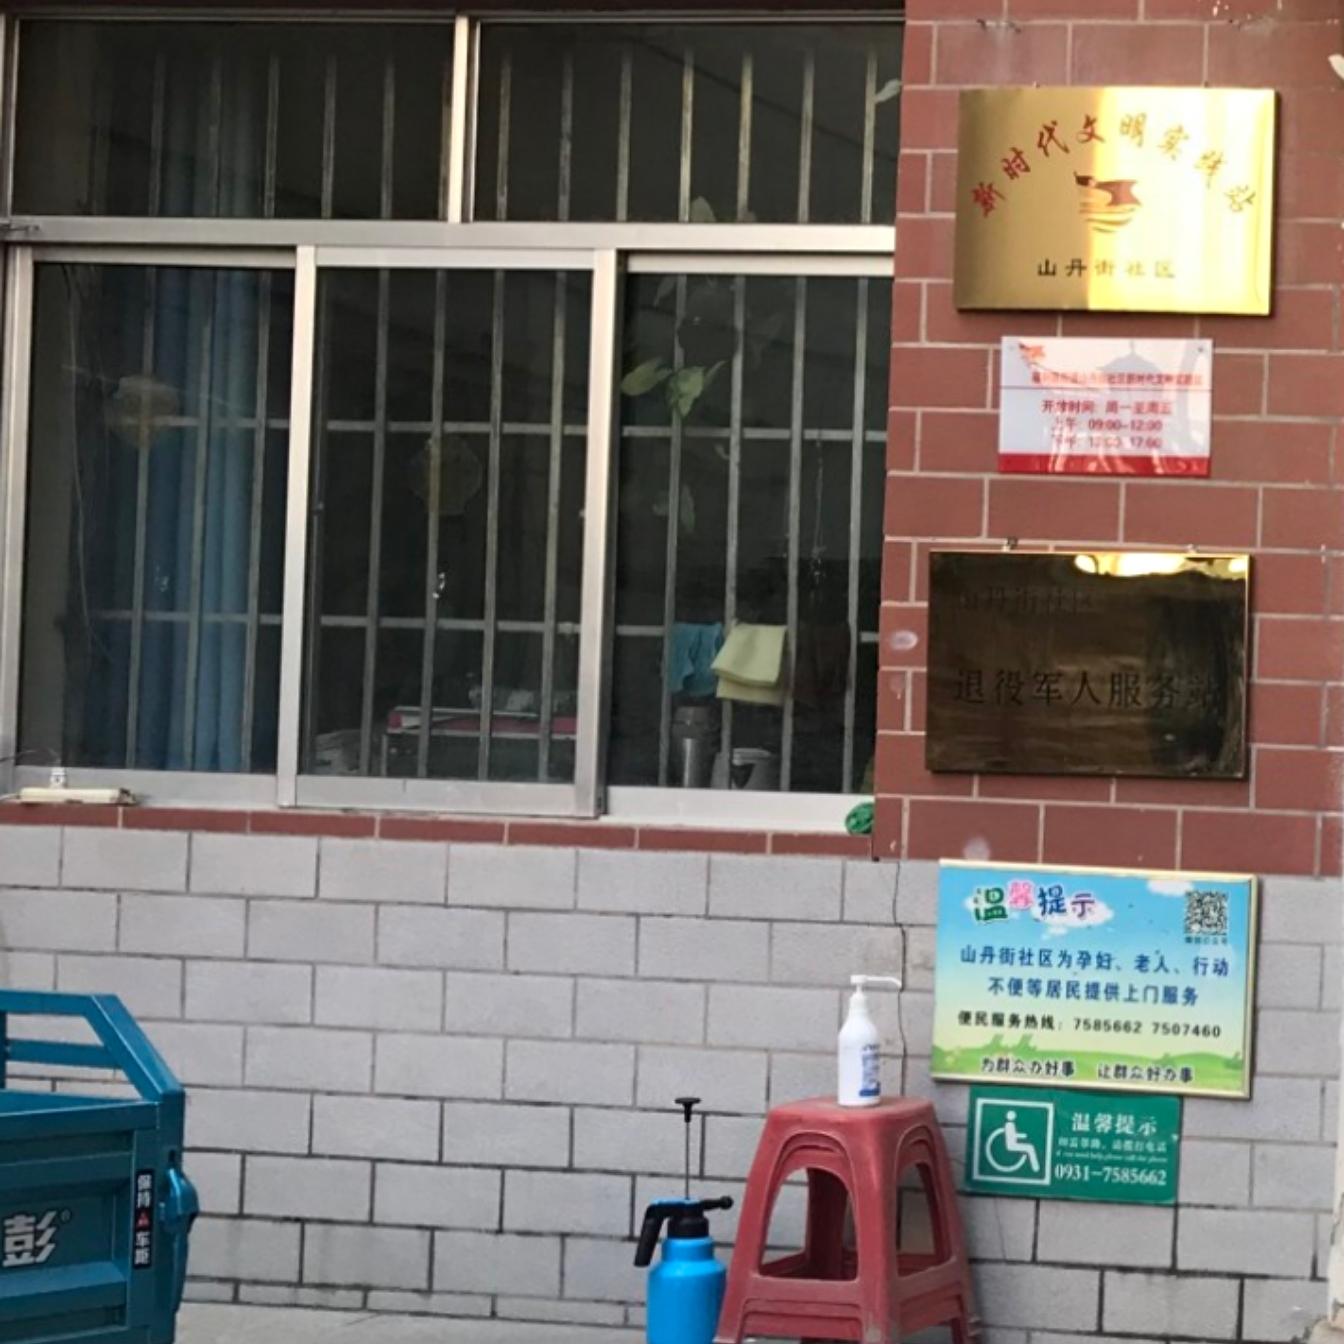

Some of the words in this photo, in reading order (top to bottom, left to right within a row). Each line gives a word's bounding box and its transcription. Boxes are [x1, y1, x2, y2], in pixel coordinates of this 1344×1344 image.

[970, 111, 1257, 218] 新时代文明实践站
[1037, 257, 1176, 279] 山丹街社区
[953, 669, 1222, 711] 退役军人服务站
[973, 880, 1096, 922] 温馨提示
[960, 944, 1229, 977] 山丹街社区为孕妇、老人、行动
[988, 977, 1199, 1007] 不便等居民提供上门服务
[1073, 1018, 1142, 1034] 7585662
[1152, 1021, 1221, 1038] 7507460
[982, 1057, 1075, 1077] 为群众办好事
[1097, 1063, 1193, 1083] 让群众好办事
[1072, 1112, 1157, 1136] 温馨提示
[136, 1173, 152, 1207] 保持
[133, 1230, 149, 1266] 车距
